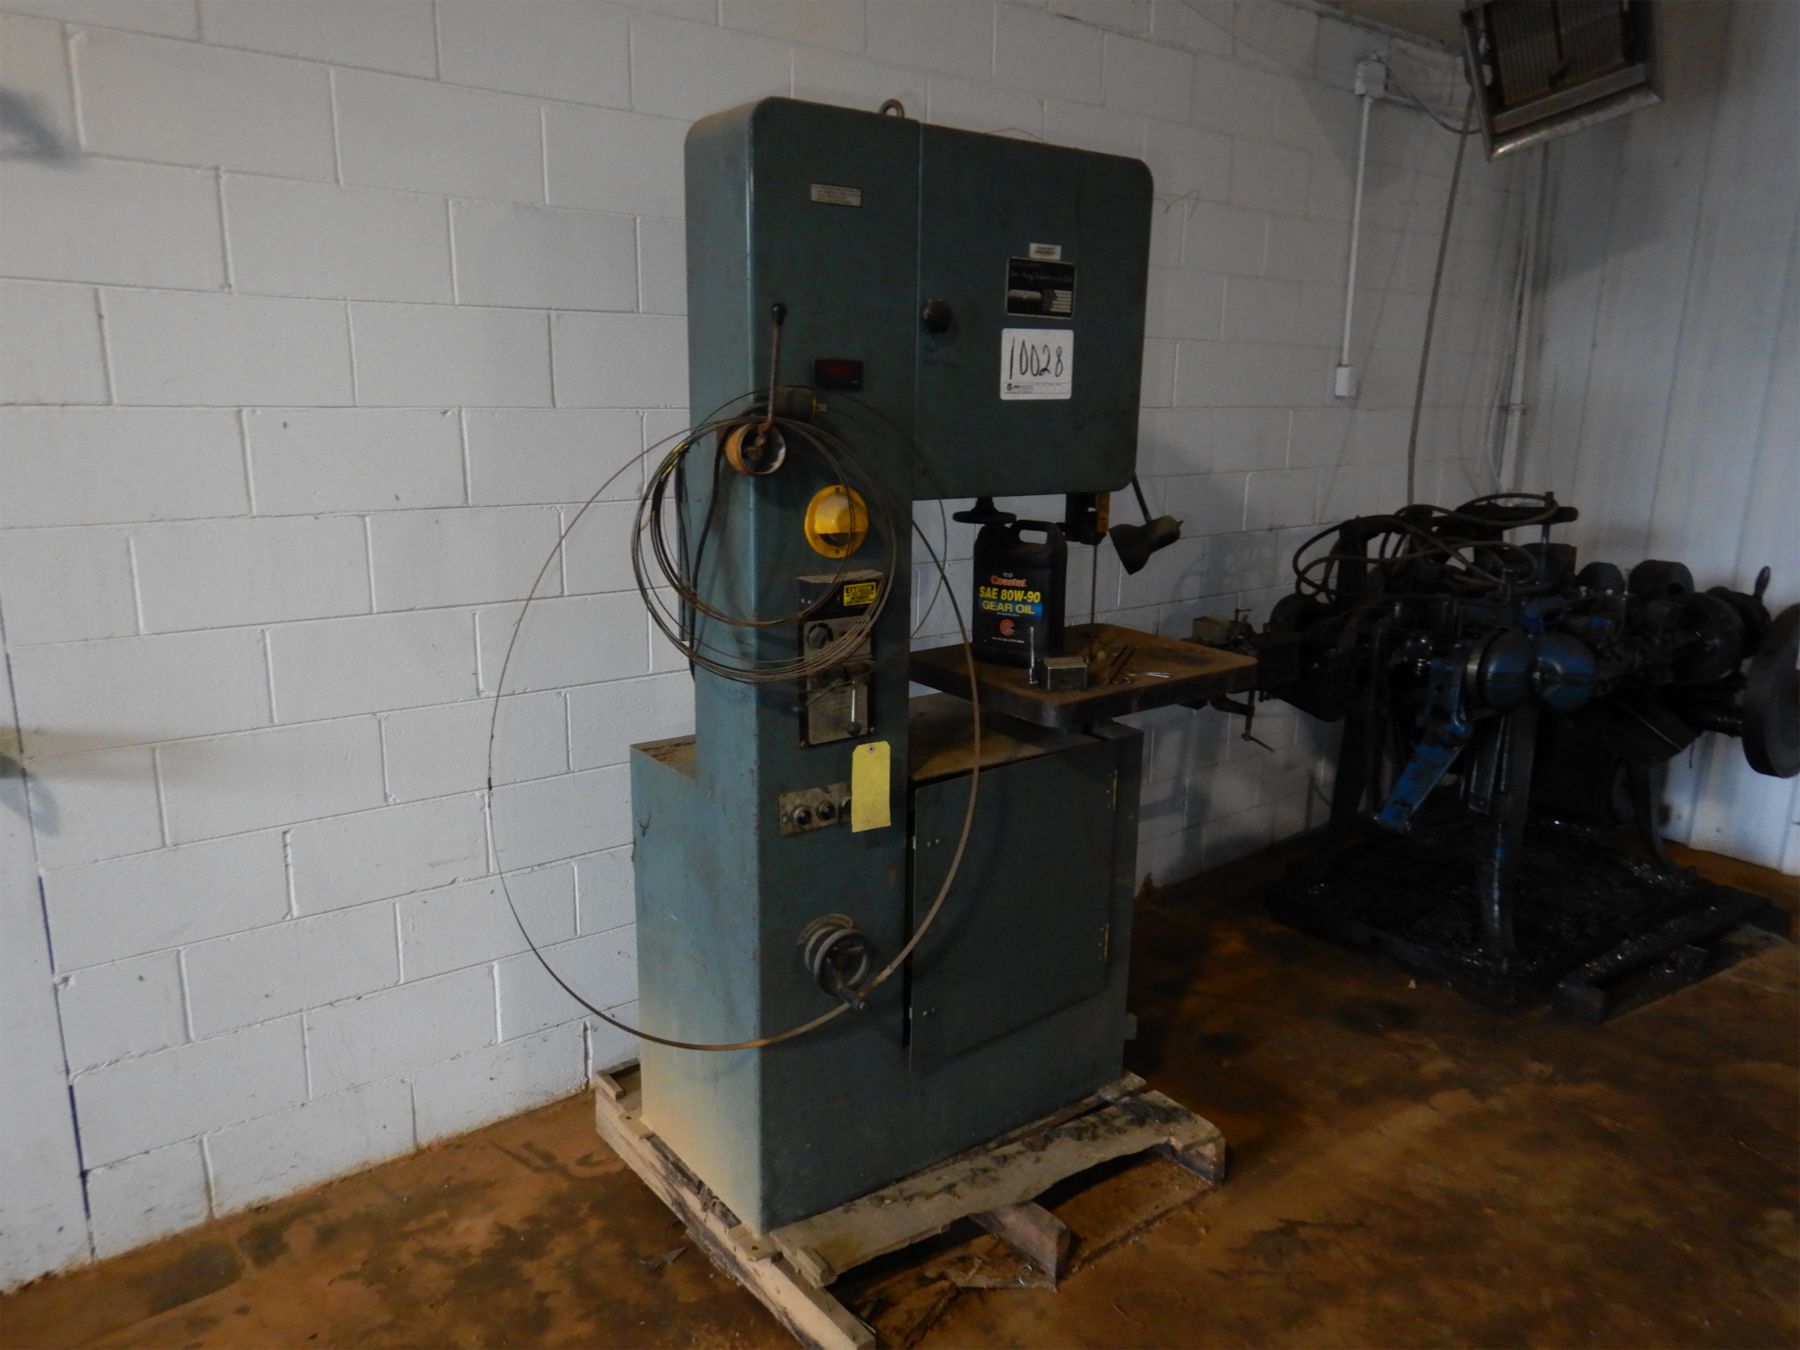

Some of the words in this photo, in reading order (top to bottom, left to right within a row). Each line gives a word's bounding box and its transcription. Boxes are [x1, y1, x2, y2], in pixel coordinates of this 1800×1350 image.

[1010, 338, 1062, 379] 10028
[979, 586, 998, 599] SAE
[1001, 589, 1041, 603] 80W-90
[983, 601, 1012, 612] GEAR
[1016, 604, 1036, 615] OIL
